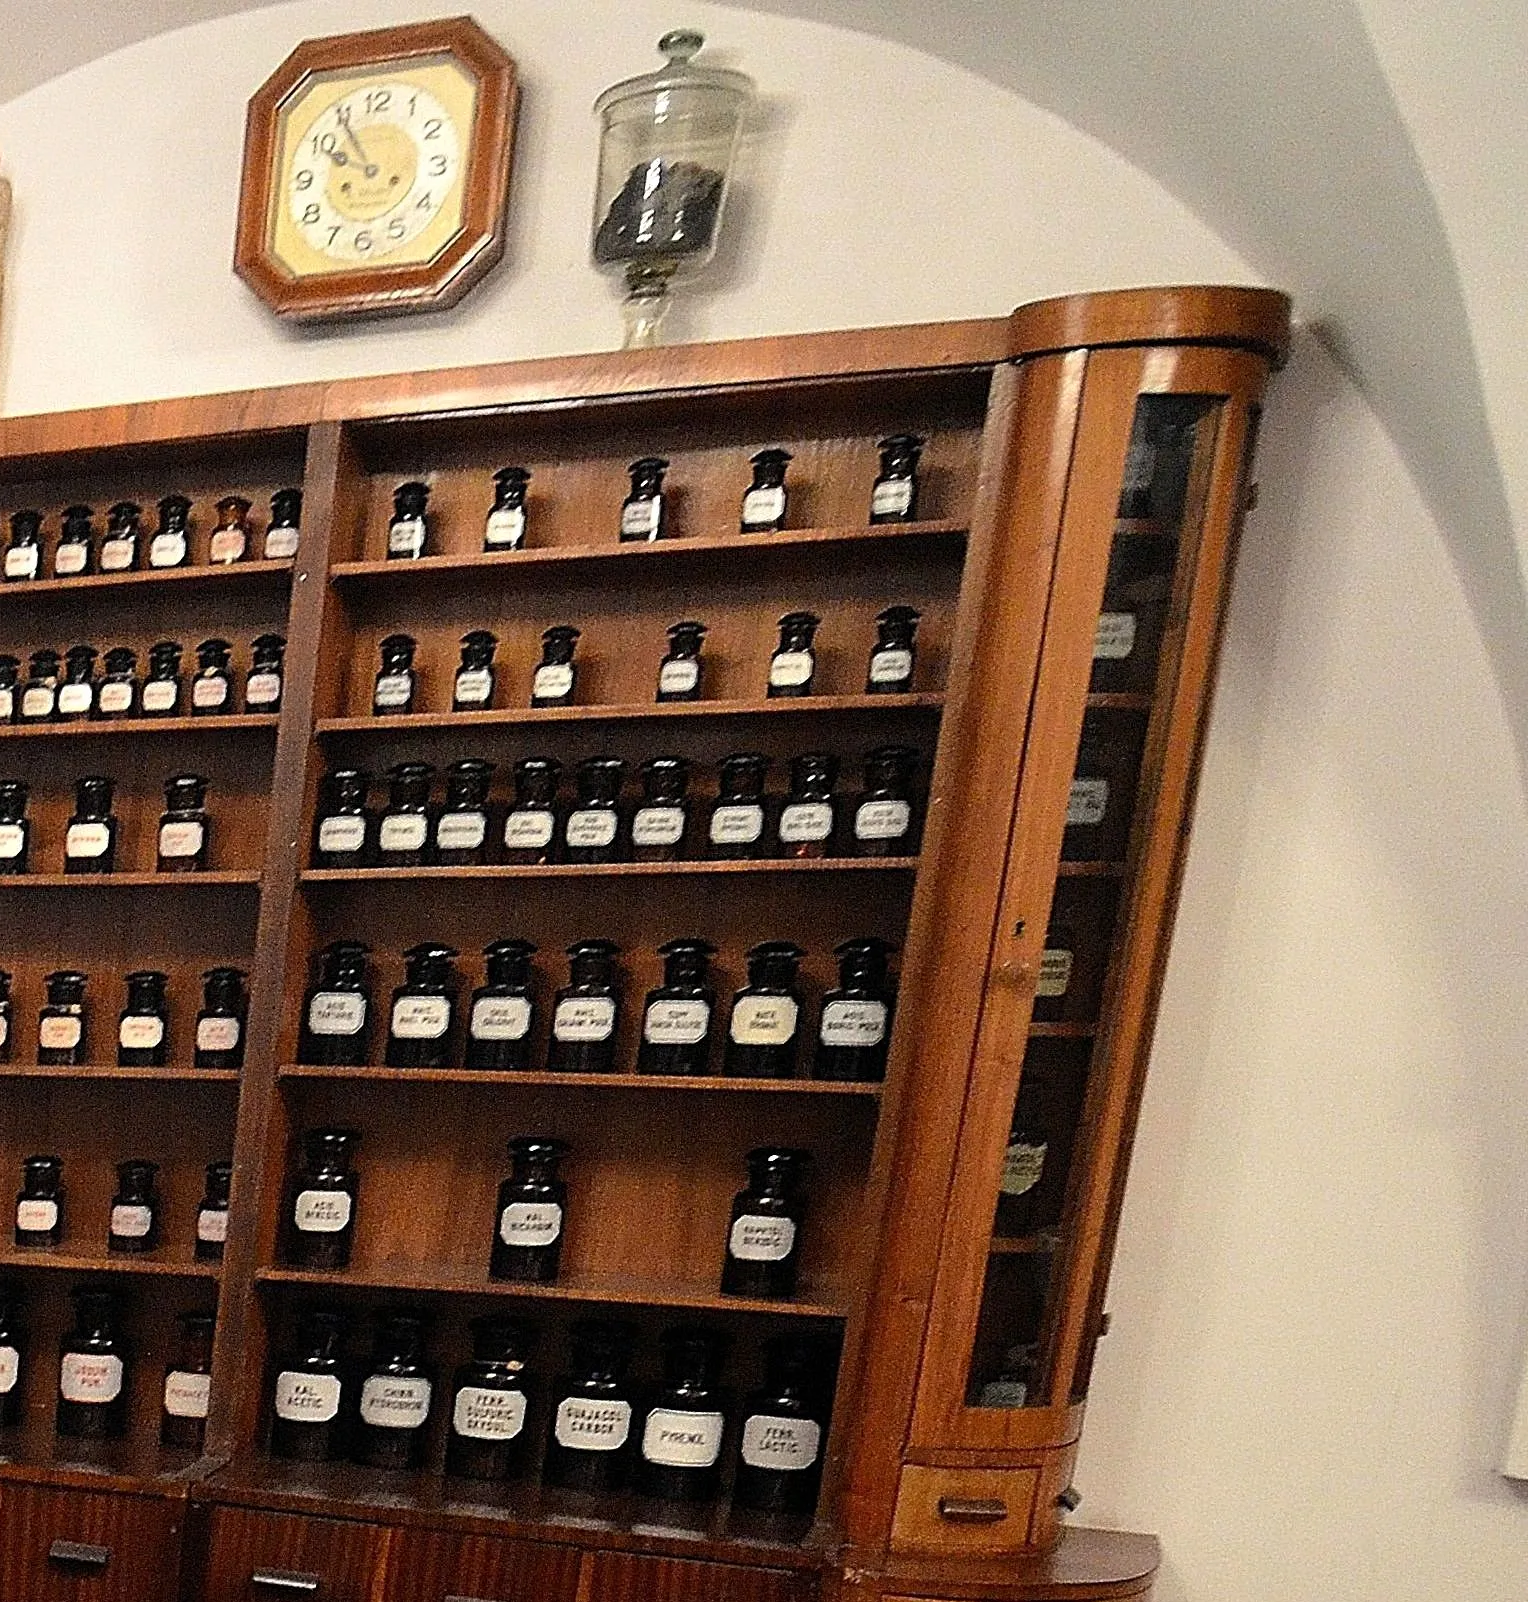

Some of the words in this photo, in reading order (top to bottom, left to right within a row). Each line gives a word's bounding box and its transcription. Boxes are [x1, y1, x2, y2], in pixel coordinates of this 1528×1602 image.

[365, 90, 392, 114] 12
[408, 96, 417, 116] 1
[424, 119, 442, 140] 2
[311, 132, 337, 155] 10
[429, 154, 447, 177] 3
[296, 169, 313, 191] 9
[416, 190, 432, 212] 4
[302, 203, 321, 225] 8
[327, 226, 342, 247] 7
[388, 218, 407, 239] 5
[354, 230, 374, 251] 6
